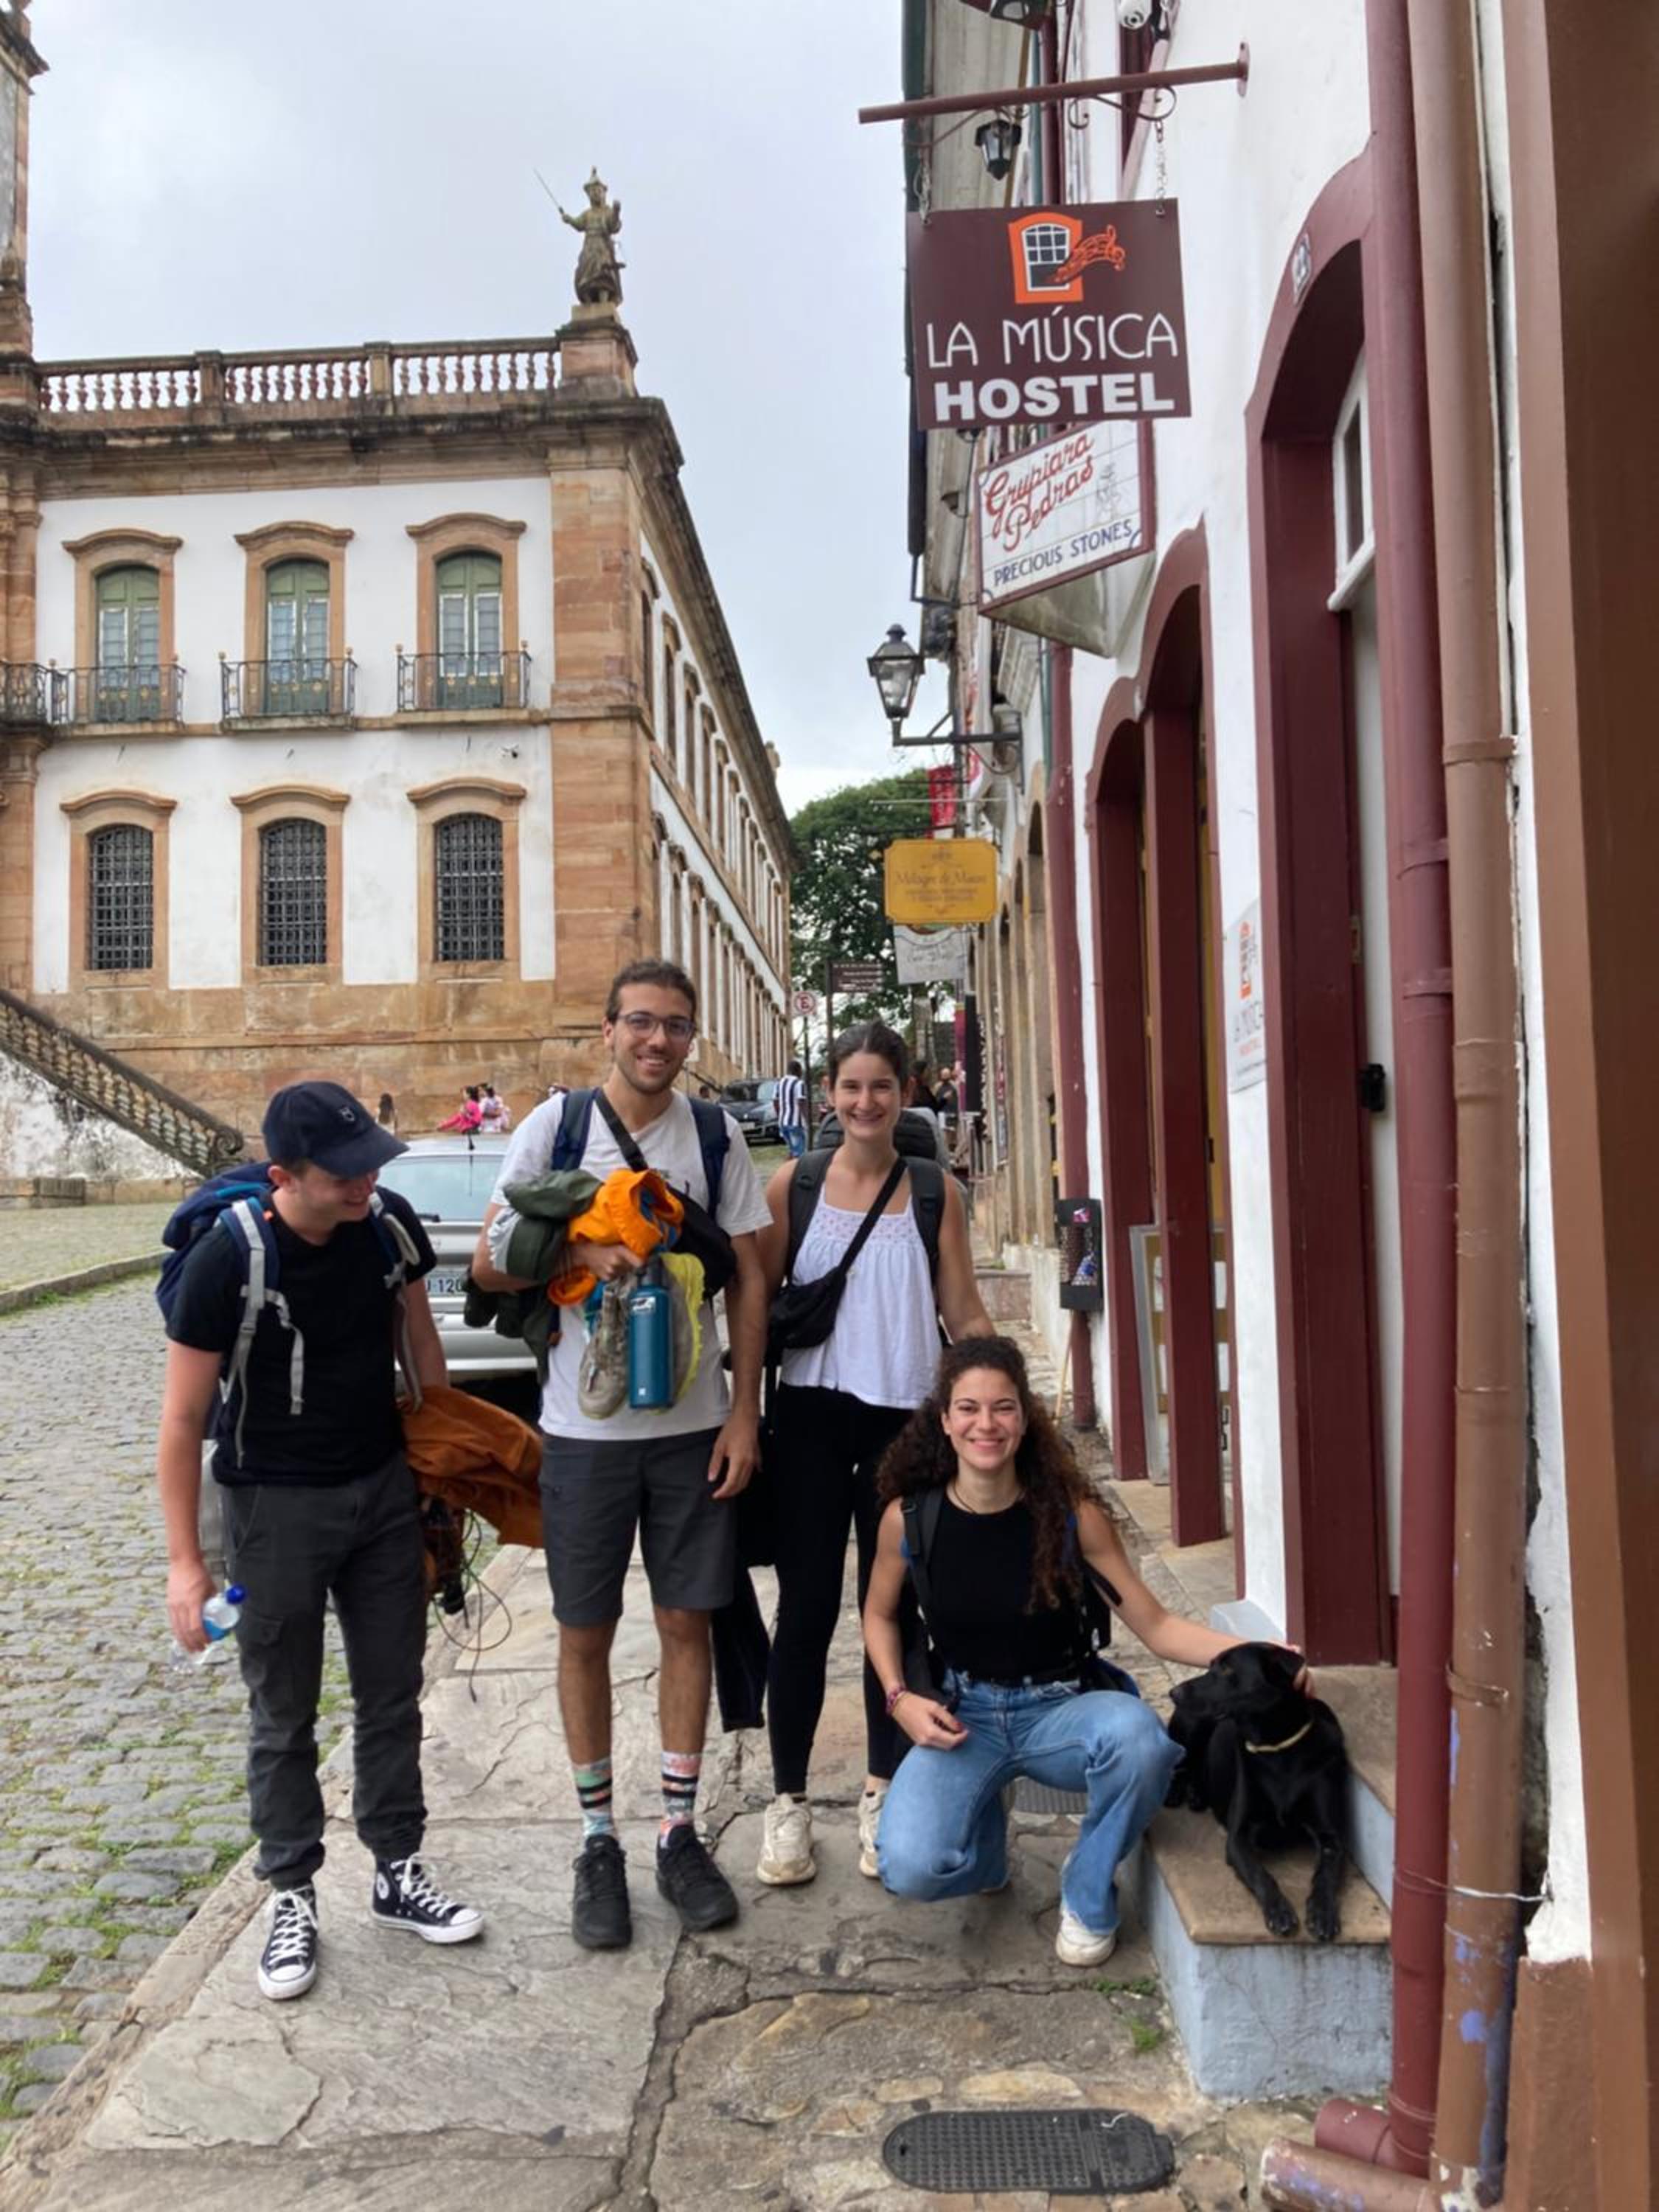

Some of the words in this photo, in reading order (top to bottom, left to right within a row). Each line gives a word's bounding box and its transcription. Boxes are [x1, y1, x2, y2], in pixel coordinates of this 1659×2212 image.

[927, 322, 979, 369] LA
[1002, 305, 1179, 365] MÚSICA
[933, 372, 1175, 422] HOSTEL
[1003, 455, 1093, 552] Pedras
[994, 546, 1062, 587] PRECIOUS
[1071, 518, 1132, 557] STONES
